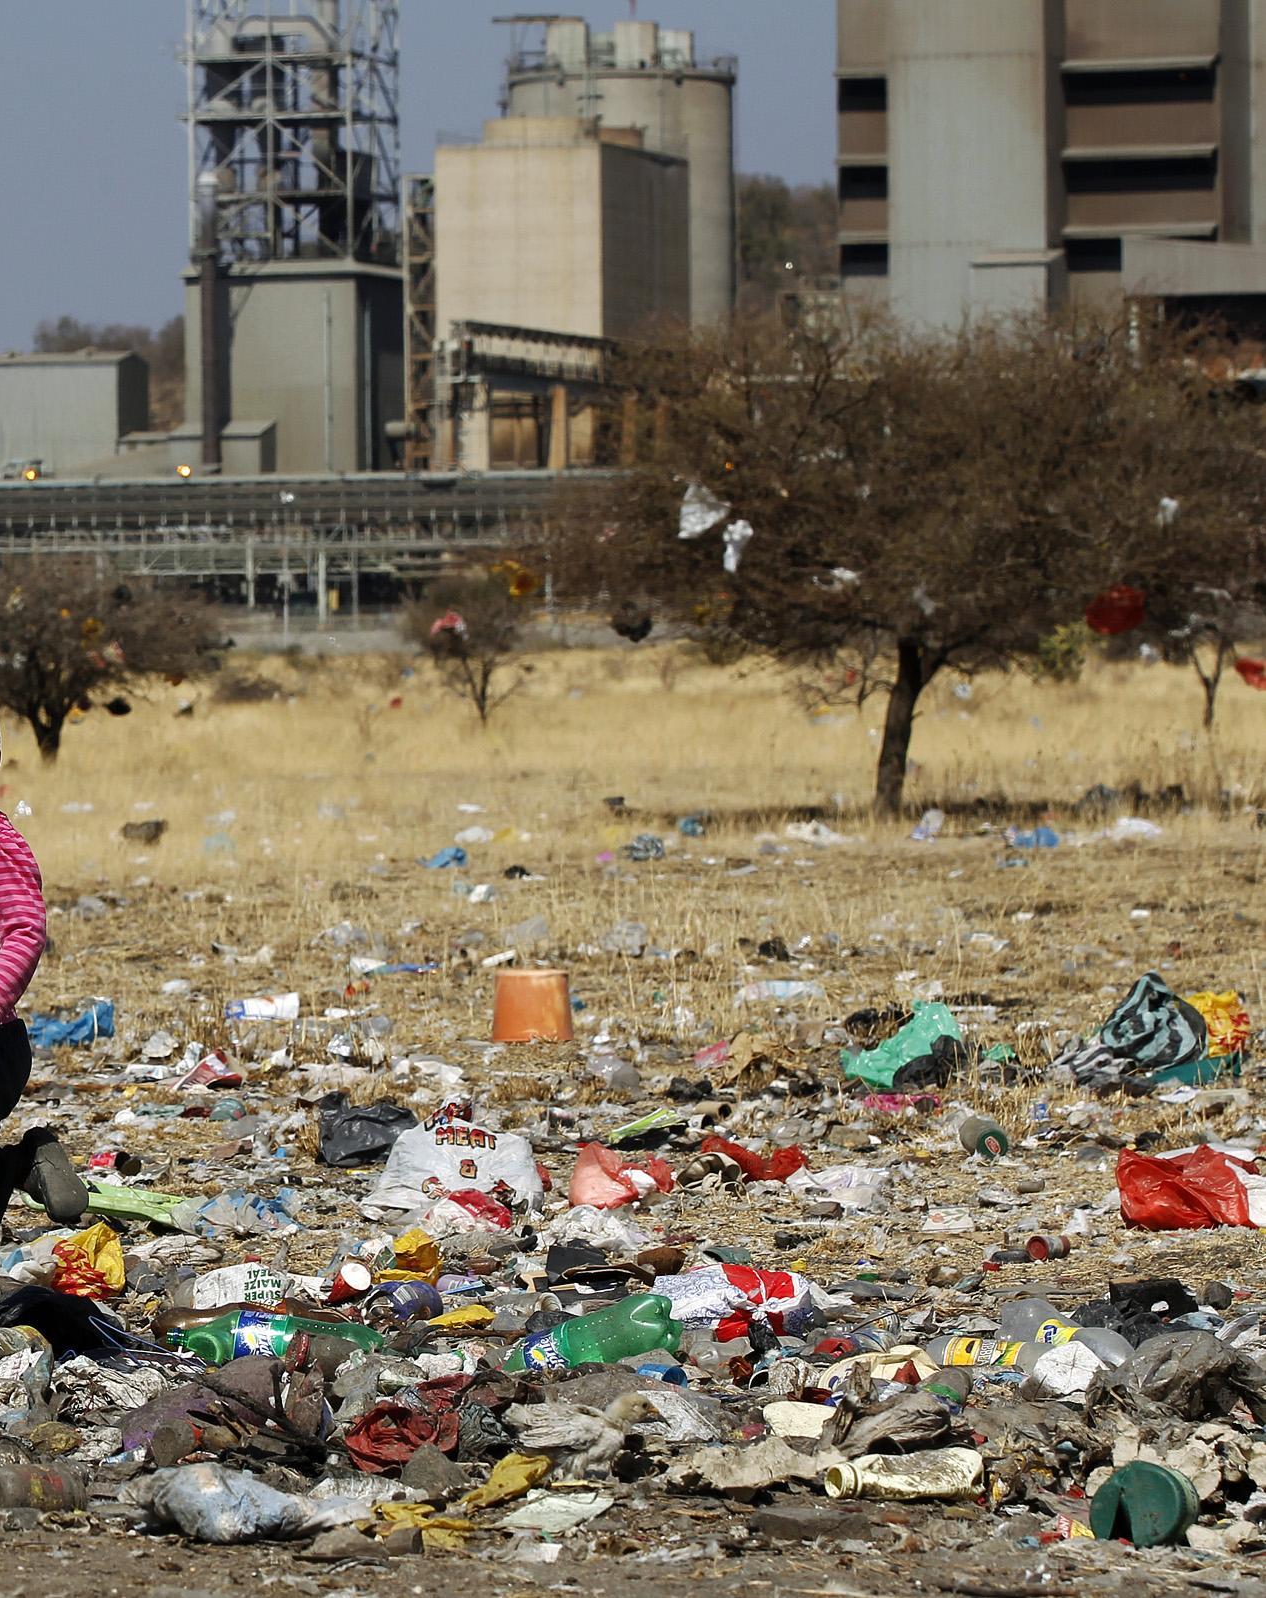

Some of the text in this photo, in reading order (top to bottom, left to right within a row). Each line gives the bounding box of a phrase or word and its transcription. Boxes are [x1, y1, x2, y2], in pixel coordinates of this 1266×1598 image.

[436, 1126, 497, 1150] MEAT
[244, 1279, 281, 1291] MAIZE
[244, 1290, 282, 1302] SUPER
